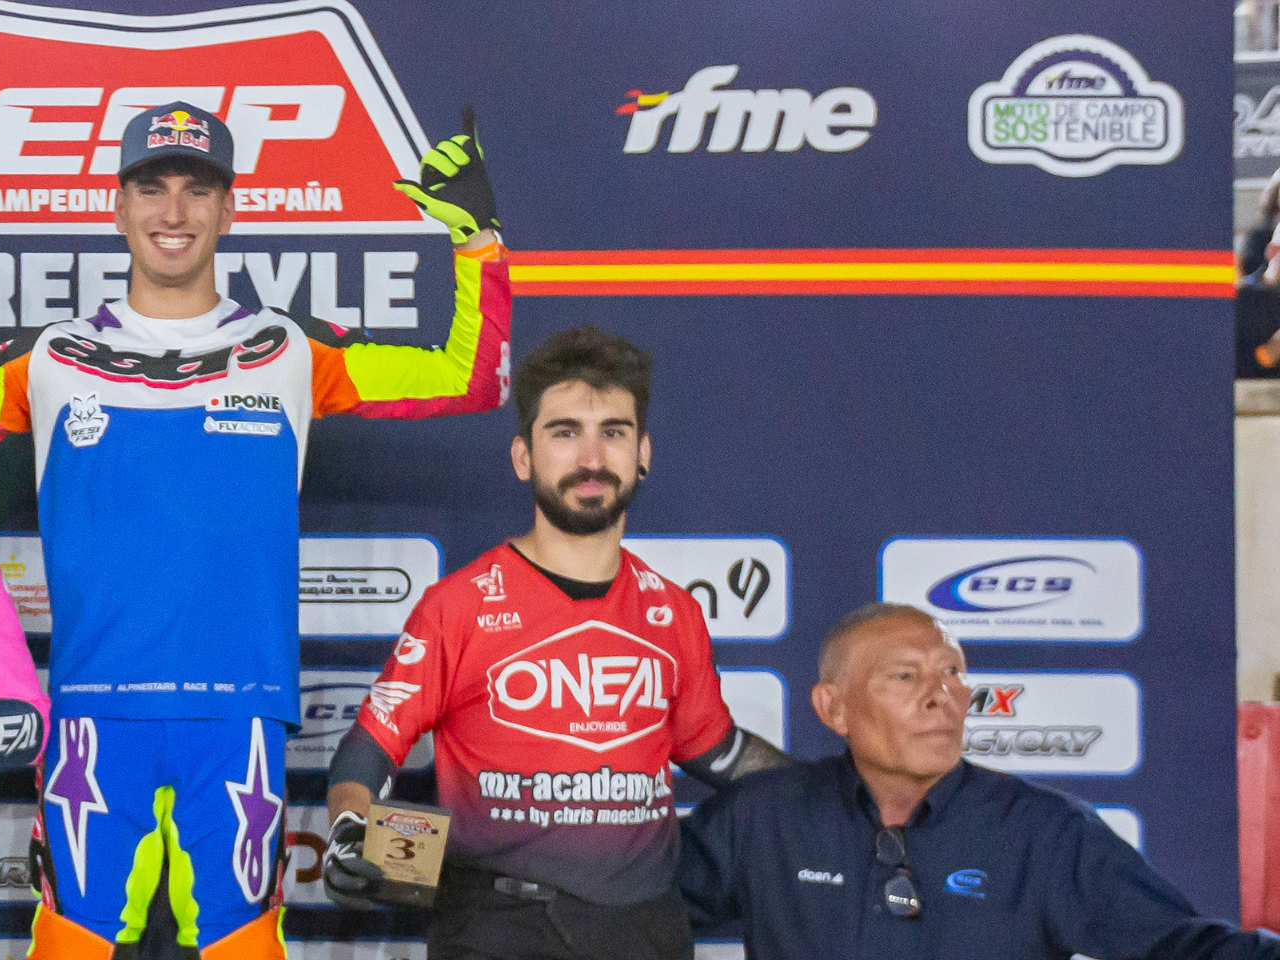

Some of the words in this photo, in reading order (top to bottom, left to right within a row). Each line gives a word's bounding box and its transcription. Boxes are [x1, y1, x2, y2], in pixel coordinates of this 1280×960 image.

[1046, 70, 1106, 91] rfme
[616, 64, 878, 153] rfme
[993, 102, 1050, 120] MOTO
[1056, 103, 1081, 120] DE
[1085, 103, 1157, 122] CAMPO
[147, 130, 179, 148] Red
[180, 131, 209, 152] Bull
[993, 119, 1157, 143] SOSTENIBLE
[234, 181, 342, 212] ESPAÑA
[224, 395, 279, 410] IPONE
[477, 611, 521, 627] VC/CA
[116, 682, 177, 692] ALPINESTARS
[183, 682, 208, 691] RACE
[213, 682, 236, 692] SPEC
[495, 653, 669, 717] O'NEAL
[962, 726, 1102, 757] CTORY
[529, 806, 550, 828] by
[553, 806, 594, 824] chris
[386, 837, 415, 860] 3
